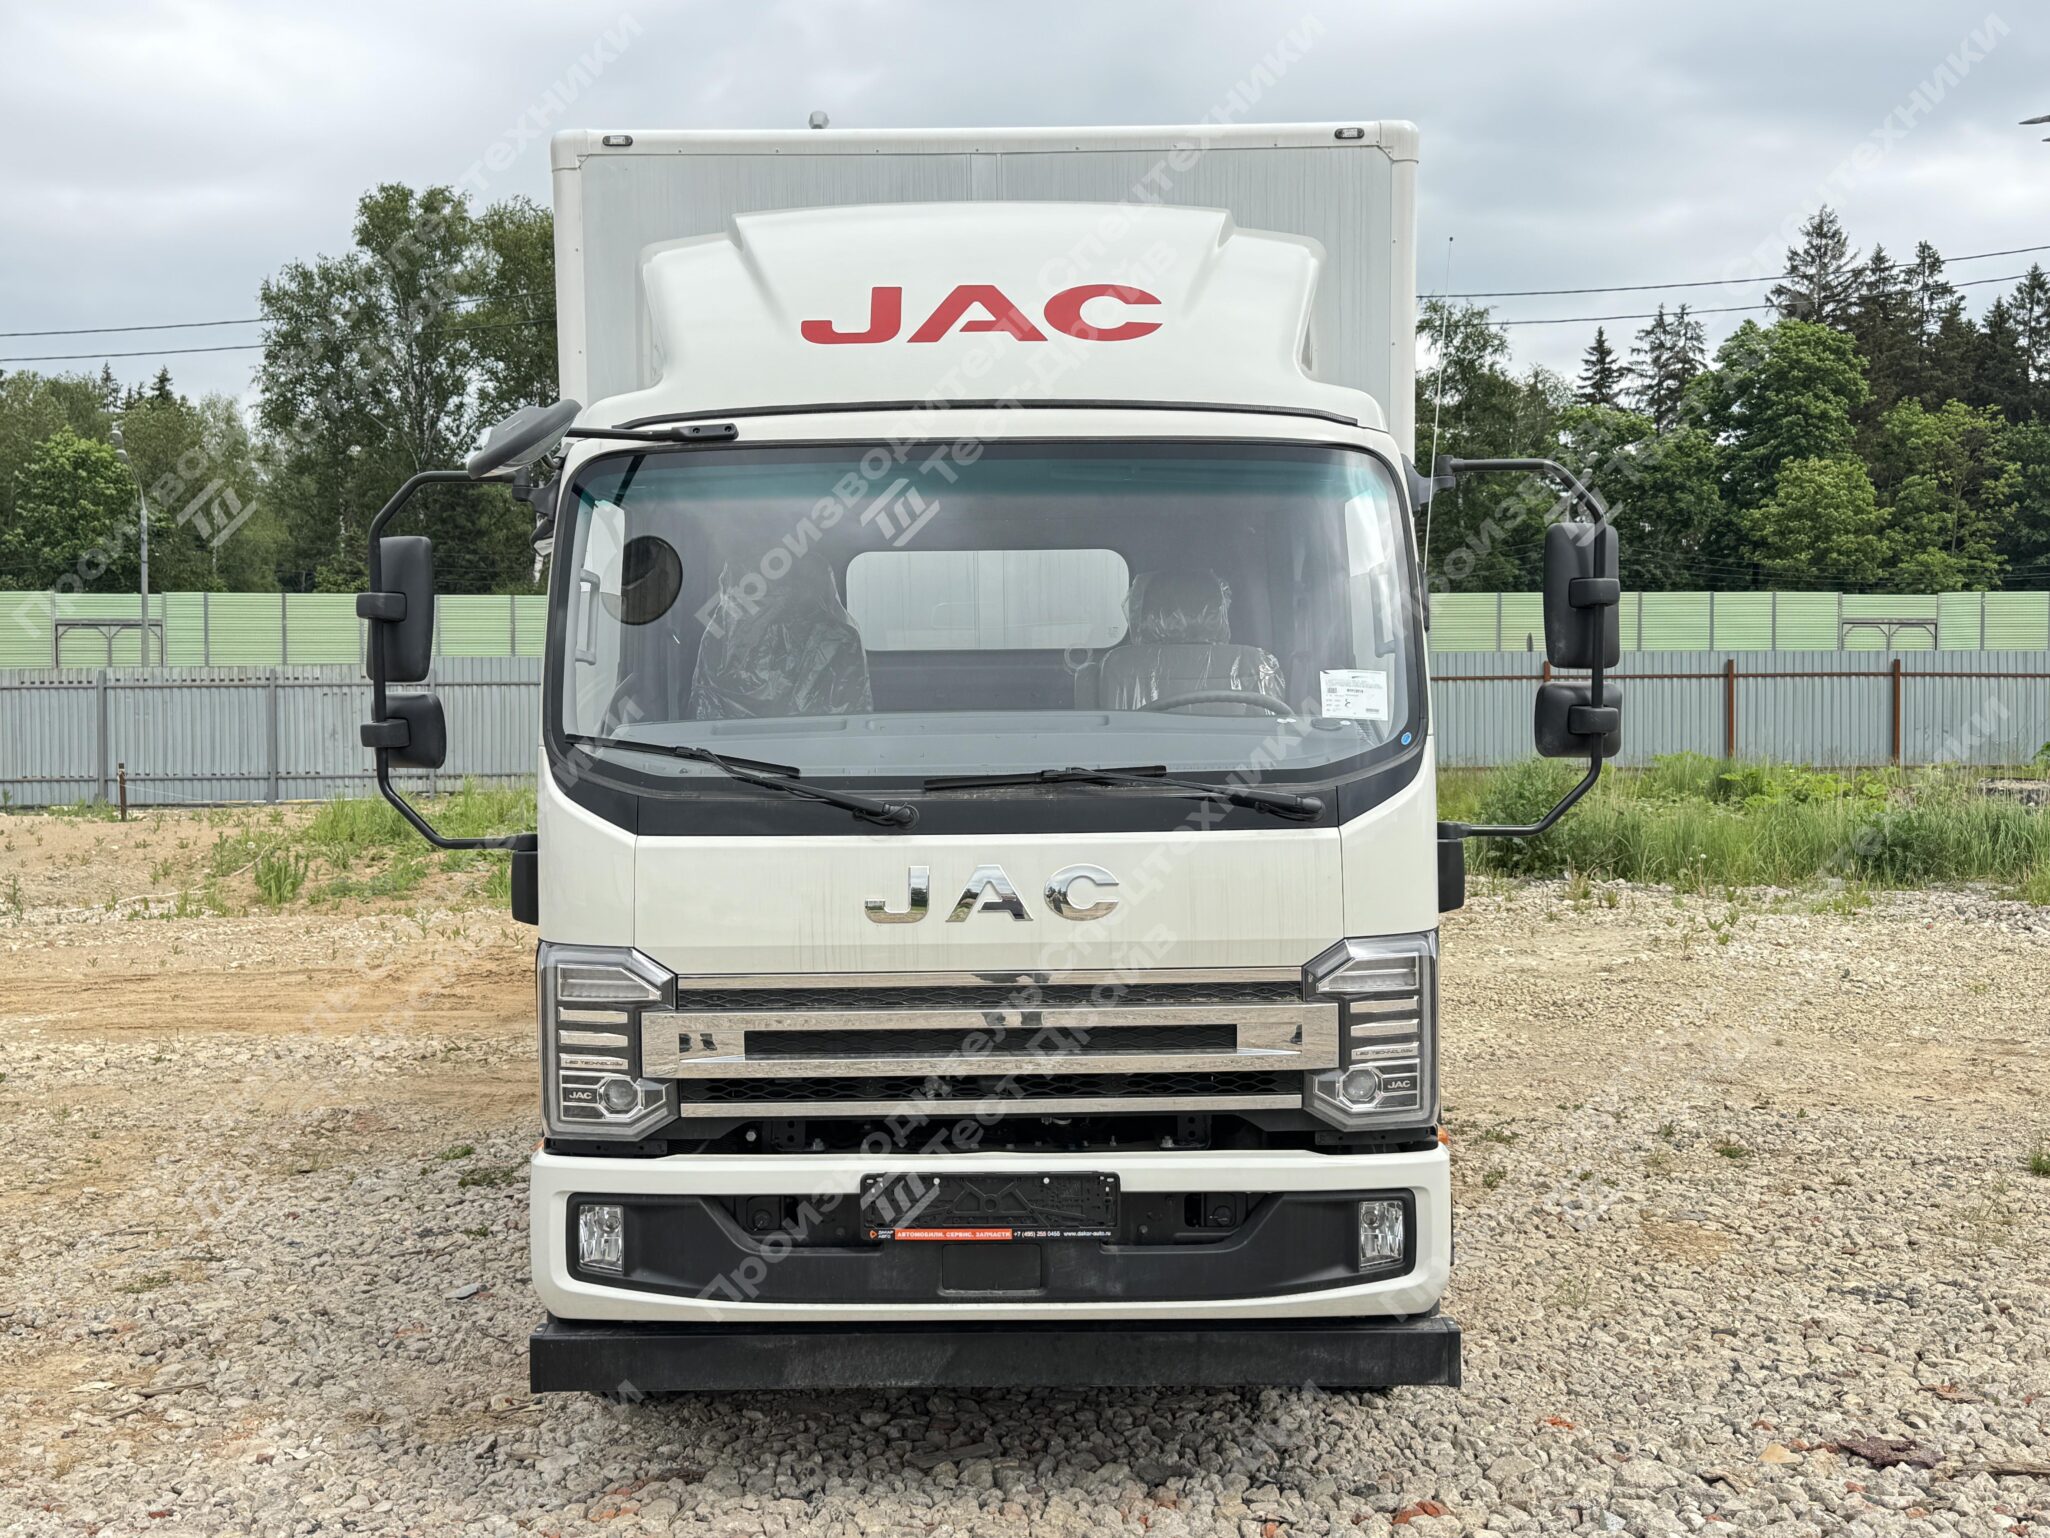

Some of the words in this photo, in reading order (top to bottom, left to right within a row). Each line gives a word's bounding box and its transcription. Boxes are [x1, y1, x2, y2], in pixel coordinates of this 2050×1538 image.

[800, 283, 1163, 344] JAC
[864, 863, 1120, 923] JAC
[568, 1091, 592, 1100] JAC
[1387, 1080, 1411, 1089] JAC
